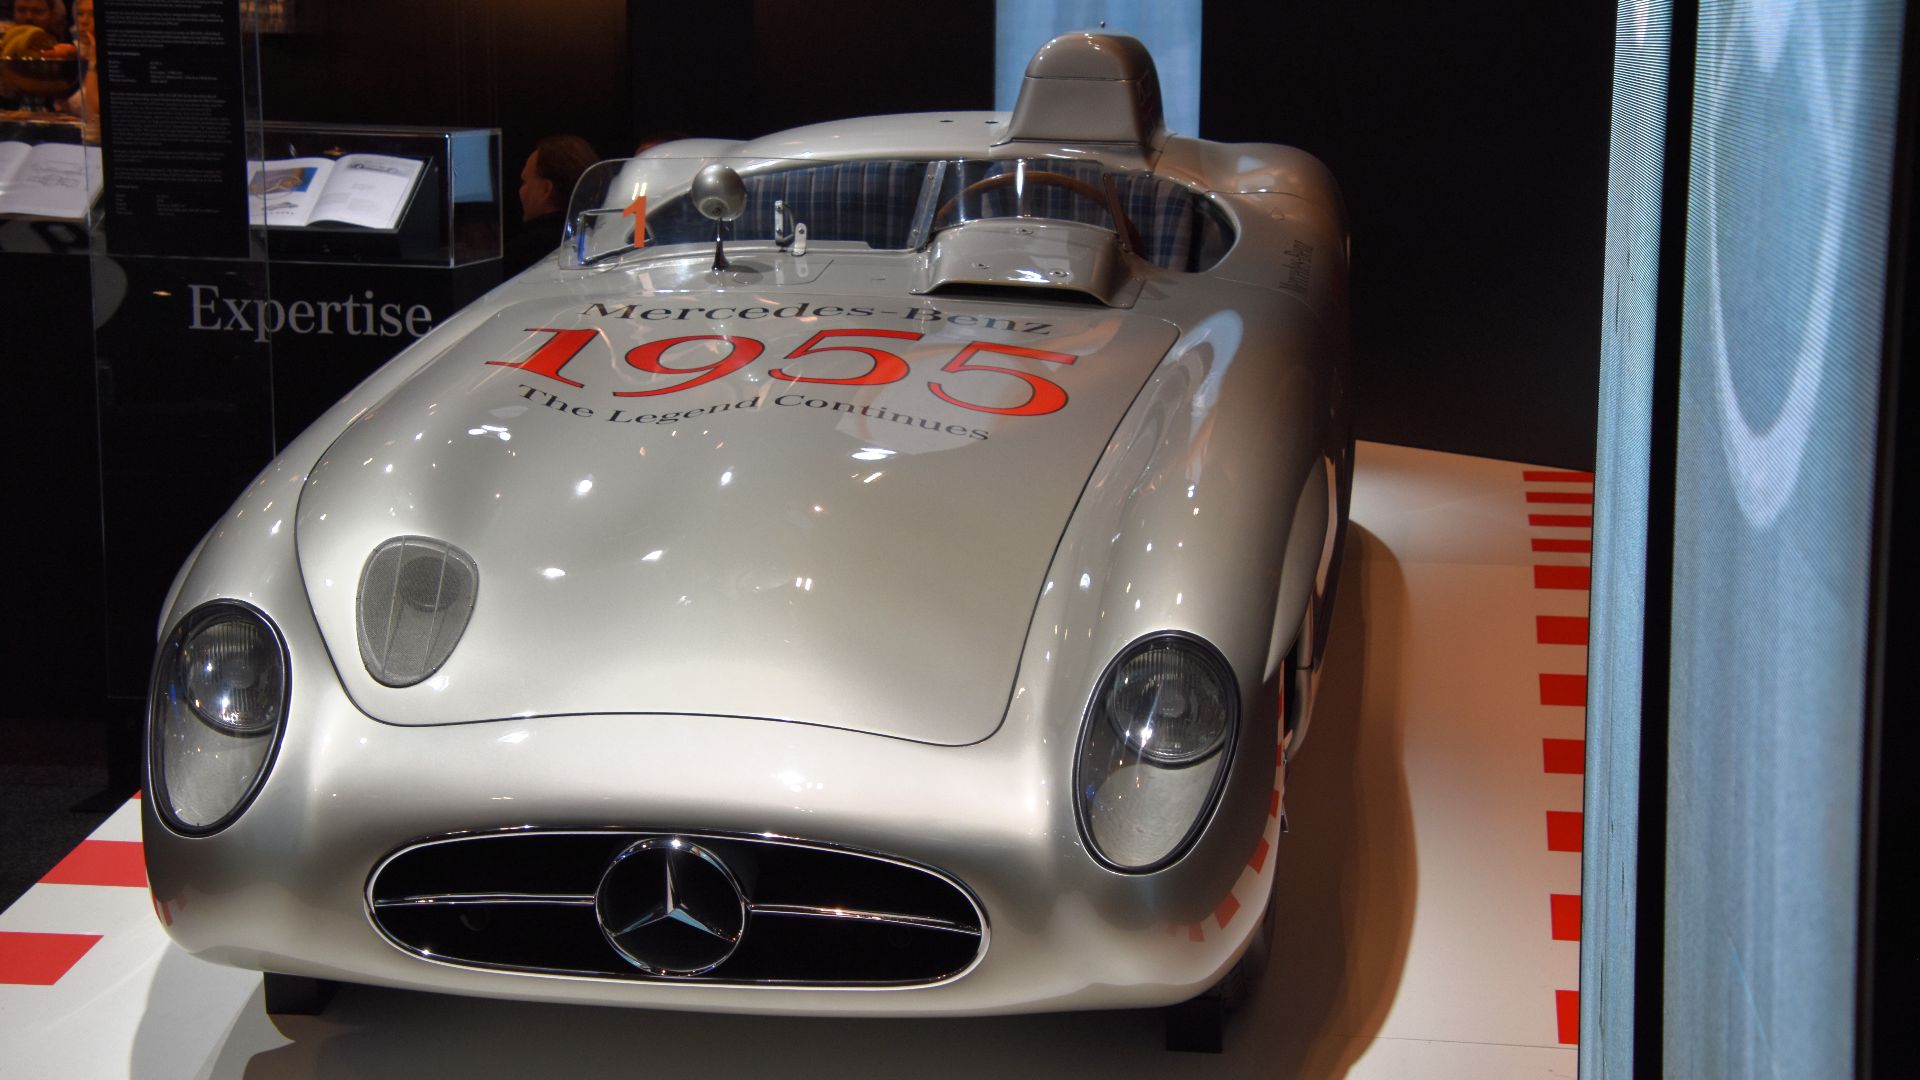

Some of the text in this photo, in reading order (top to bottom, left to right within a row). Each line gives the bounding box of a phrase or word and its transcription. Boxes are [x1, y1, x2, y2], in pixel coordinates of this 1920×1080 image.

[623, 195, 647, 248] 1
[188, 284, 432, 343] Expertise
[576, 302, 1056, 335] Mercedes-Benz
[484, 327, 1079, 416] 1955
[518, 383, 990, 441] The Legend Continues
